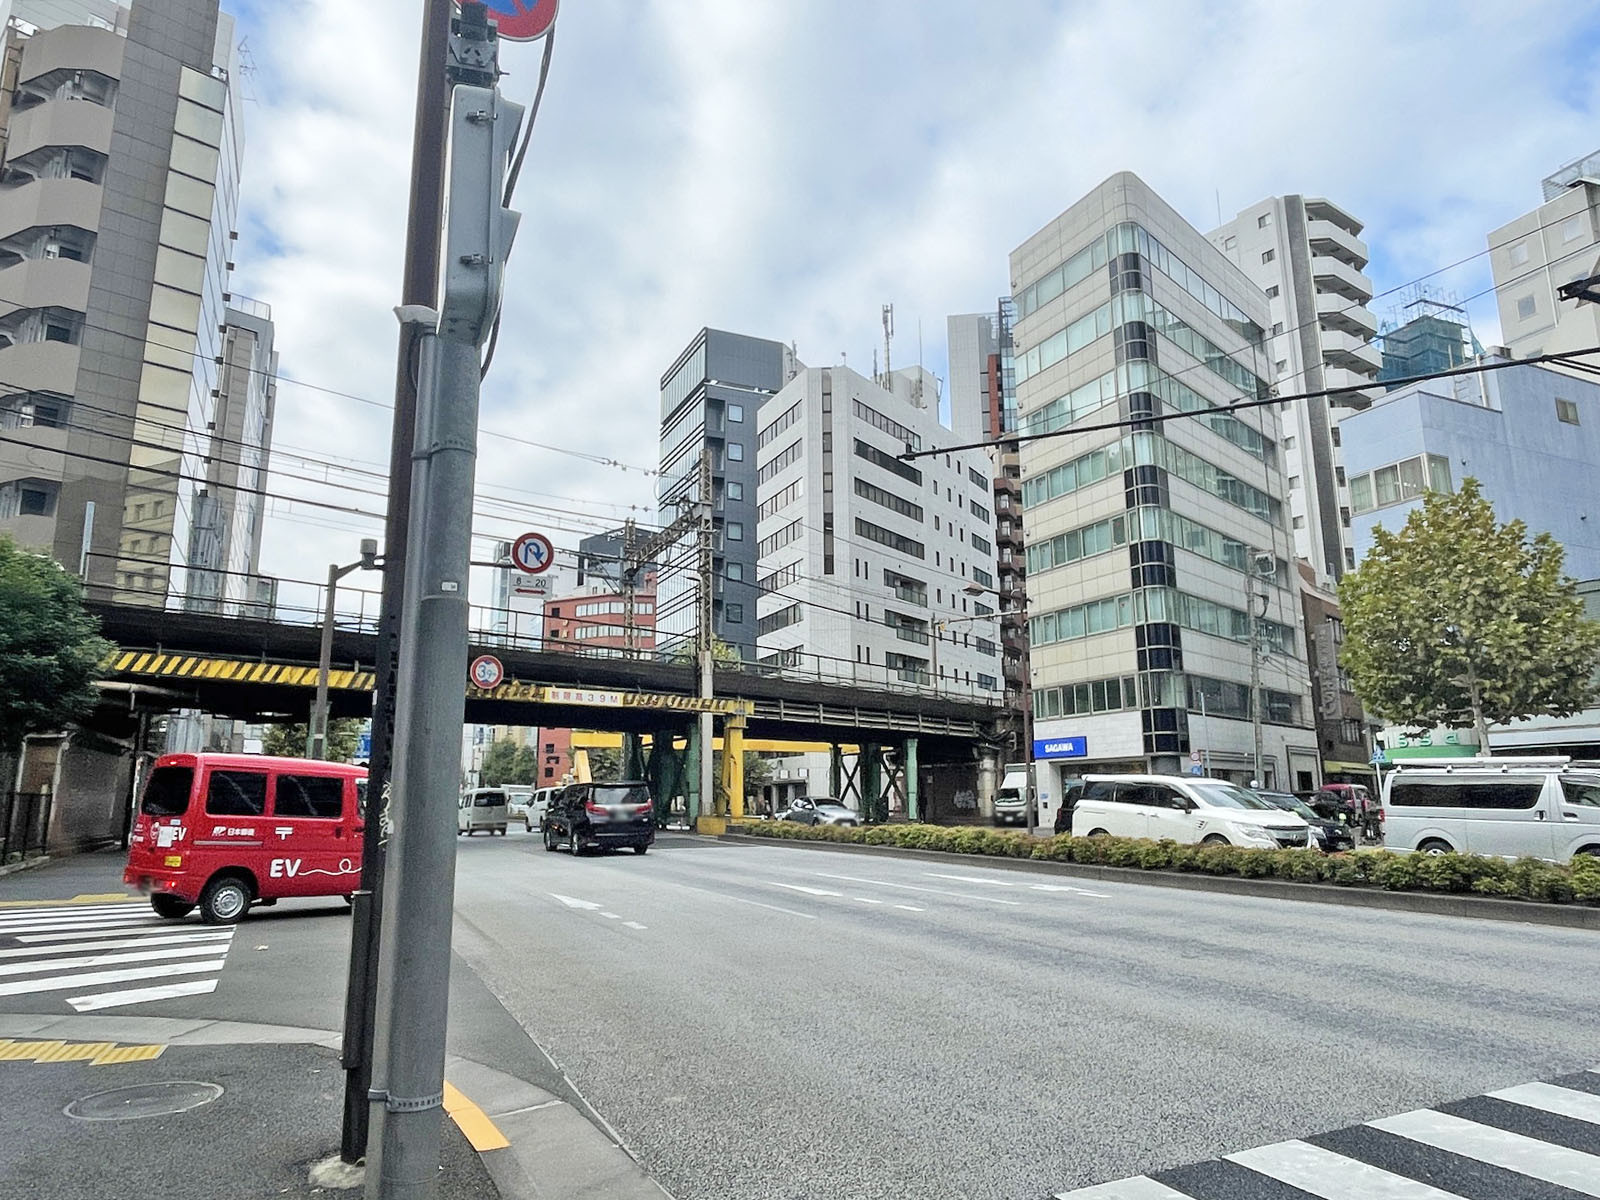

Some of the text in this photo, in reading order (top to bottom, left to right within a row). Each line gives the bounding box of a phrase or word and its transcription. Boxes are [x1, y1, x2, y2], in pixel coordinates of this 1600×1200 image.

[1045, 743, 1073, 753] SAGAWA
[171, 827, 187, 841] EV
[270, 859, 301, 877] EV
